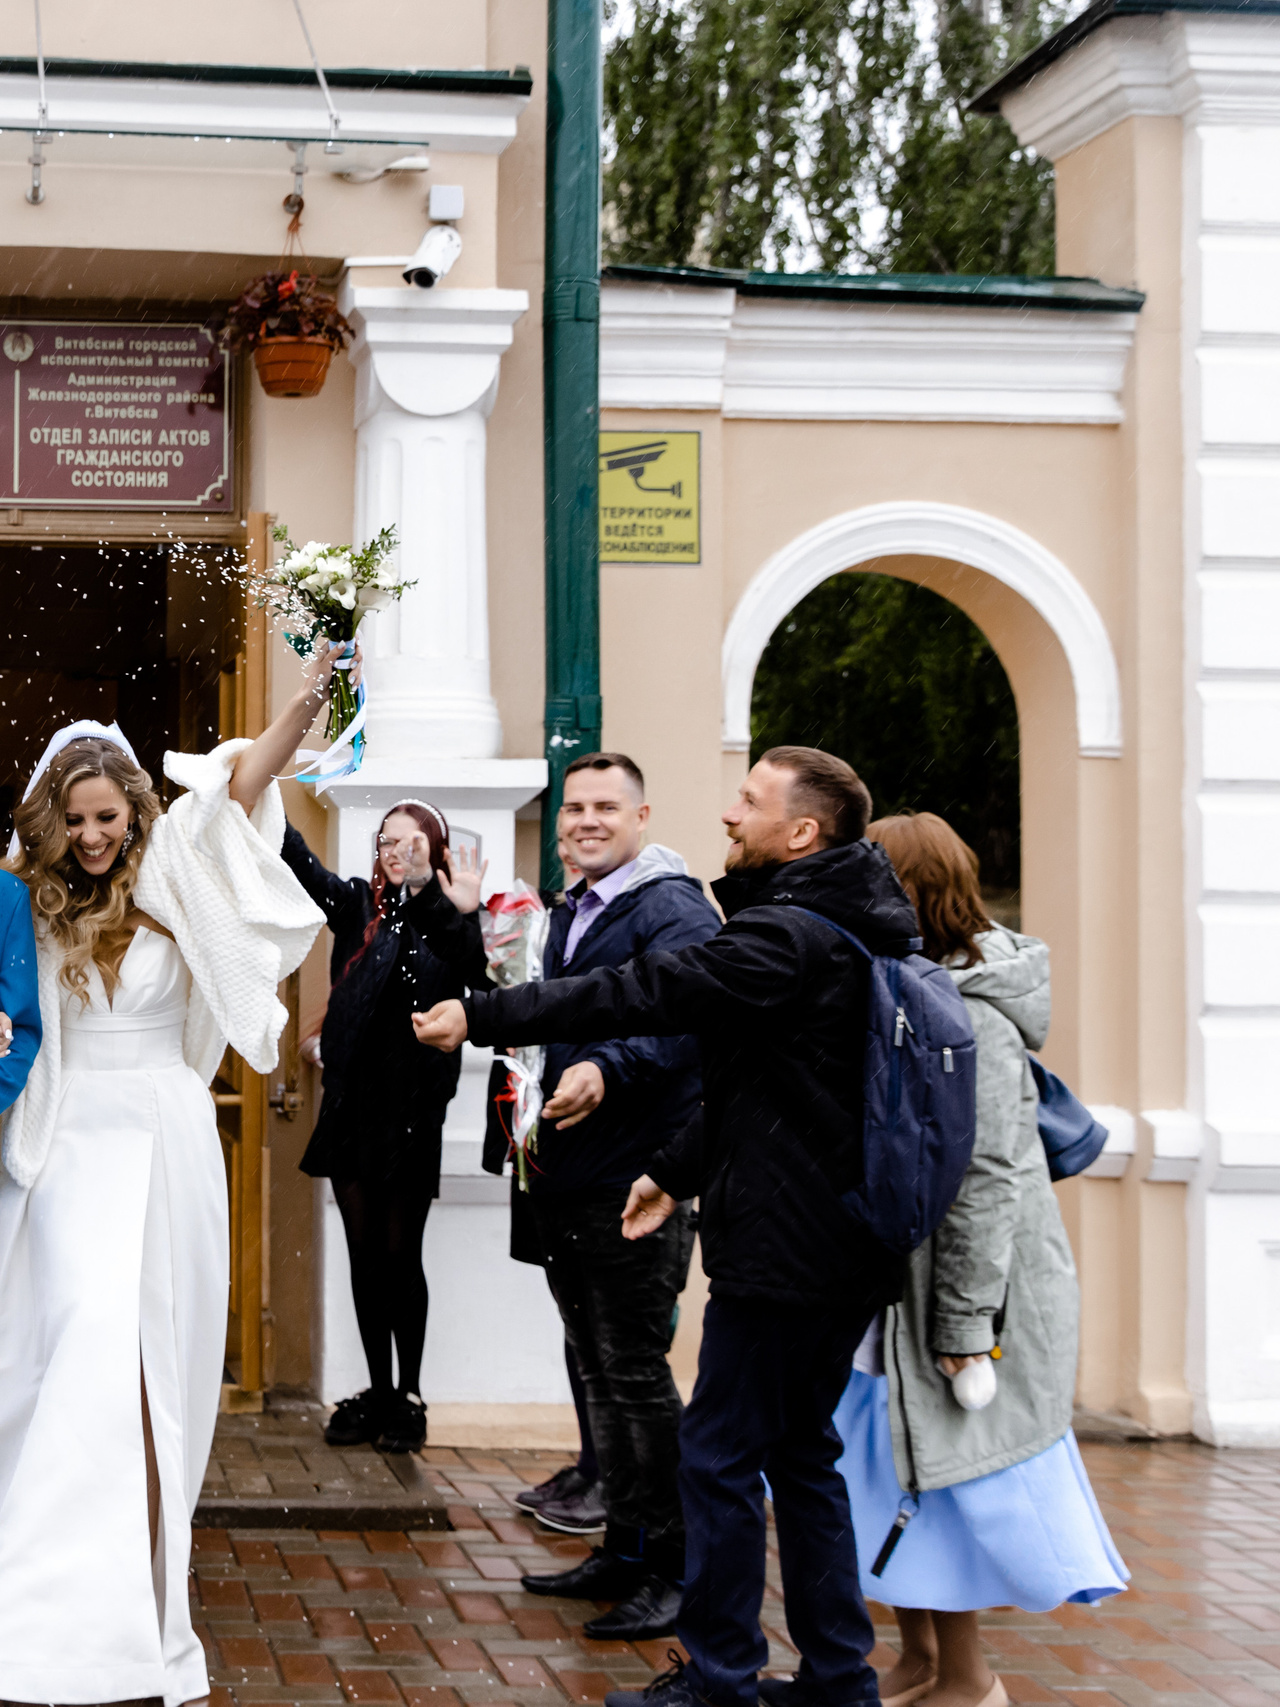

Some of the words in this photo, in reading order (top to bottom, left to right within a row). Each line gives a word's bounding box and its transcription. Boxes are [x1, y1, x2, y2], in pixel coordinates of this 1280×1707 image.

[54, 336, 124, 351] Витебский
[129, 337, 197, 352] городской
[40, 354, 153, 367] исполнительный
[67, 372, 177, 388] Администрация
[28, 387, 162, 404] Железнодорожного
[166, 389, 215, 405] района
[85, 405, 159, 419] г.Витебска
[29, 427, 83, 446] ОТДЕЛ
[88, 429, 152, 445] ЗАПИСИ
[158, 429, 211, 446] АКТОВ
[56, 449, 184, 468] ГРАЖДАНСКОГО
[71, 470, 169, 488] СОСТОЯНИЯ
[601, 507, 692, 519] ТЕРРИТОРИИ
[604, 523, 664, 537] ВЕДЁТСЯ
